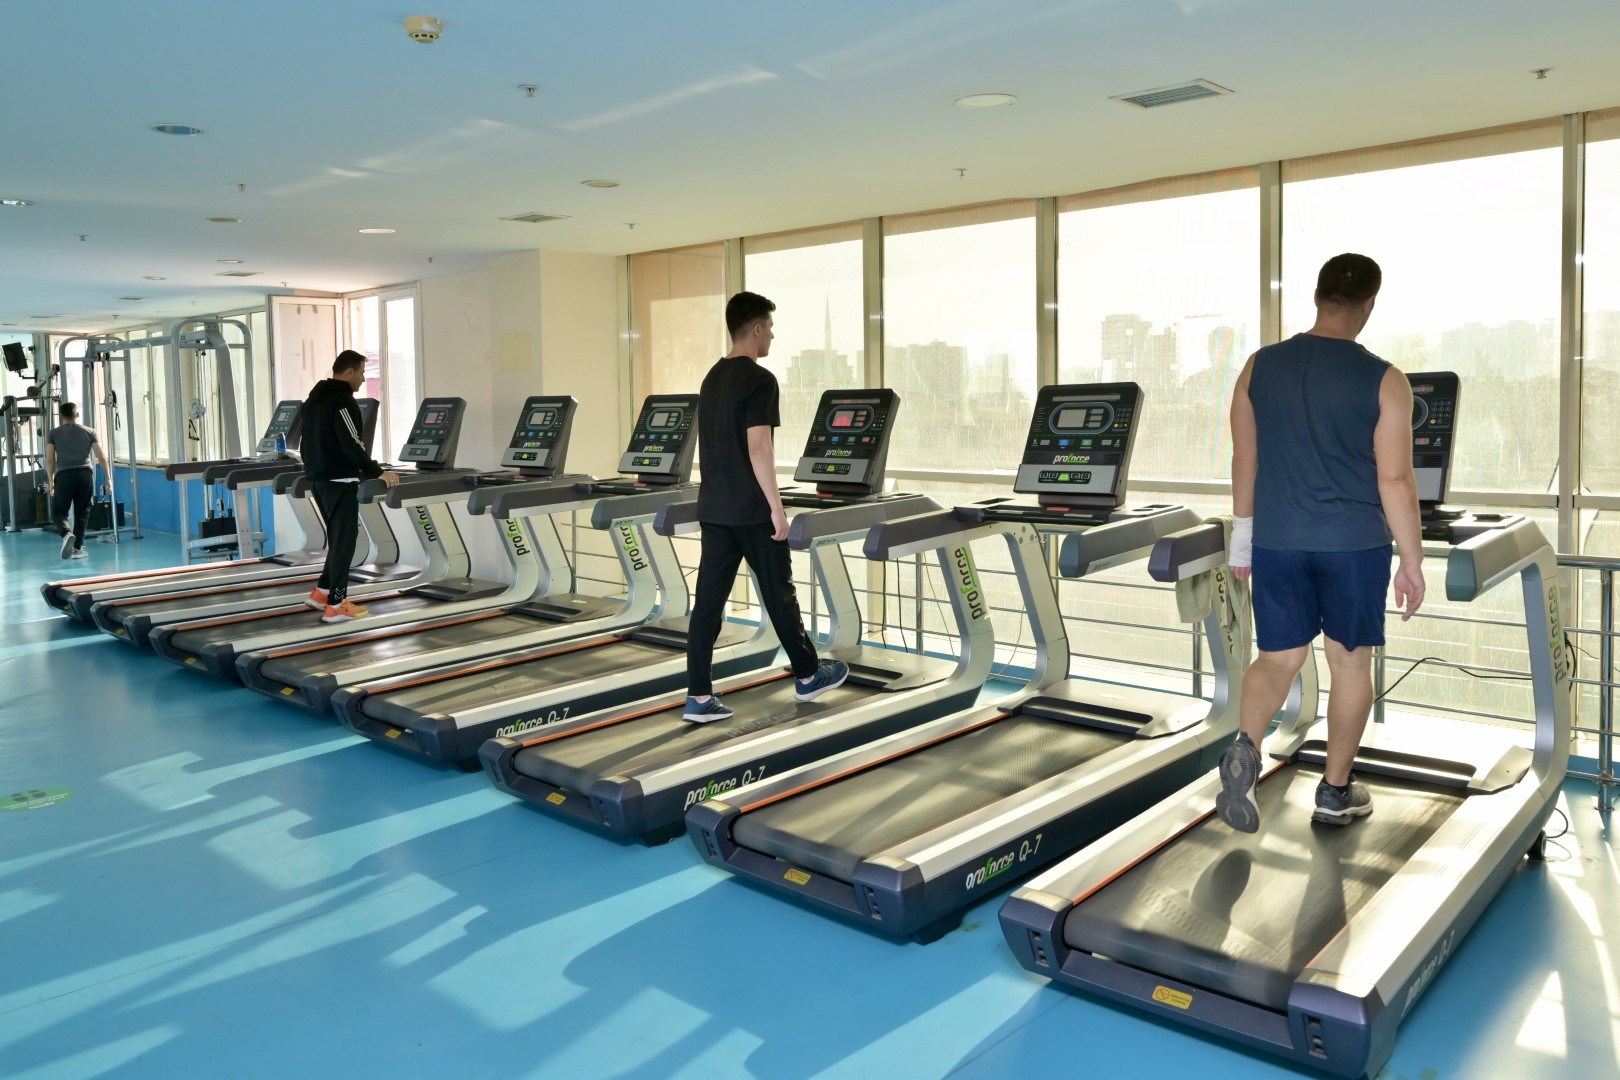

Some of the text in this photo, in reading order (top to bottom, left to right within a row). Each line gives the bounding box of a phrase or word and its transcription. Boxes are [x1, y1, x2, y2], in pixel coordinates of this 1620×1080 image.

[1053, 454, 1090, 464] proforce
[954, 546, 988, 620] proforce
[548, 707, 570, 724] Q-7
[684, 765, 766, 811] proforce Q-7
[1019, 834, 1043, 862] Q-7
